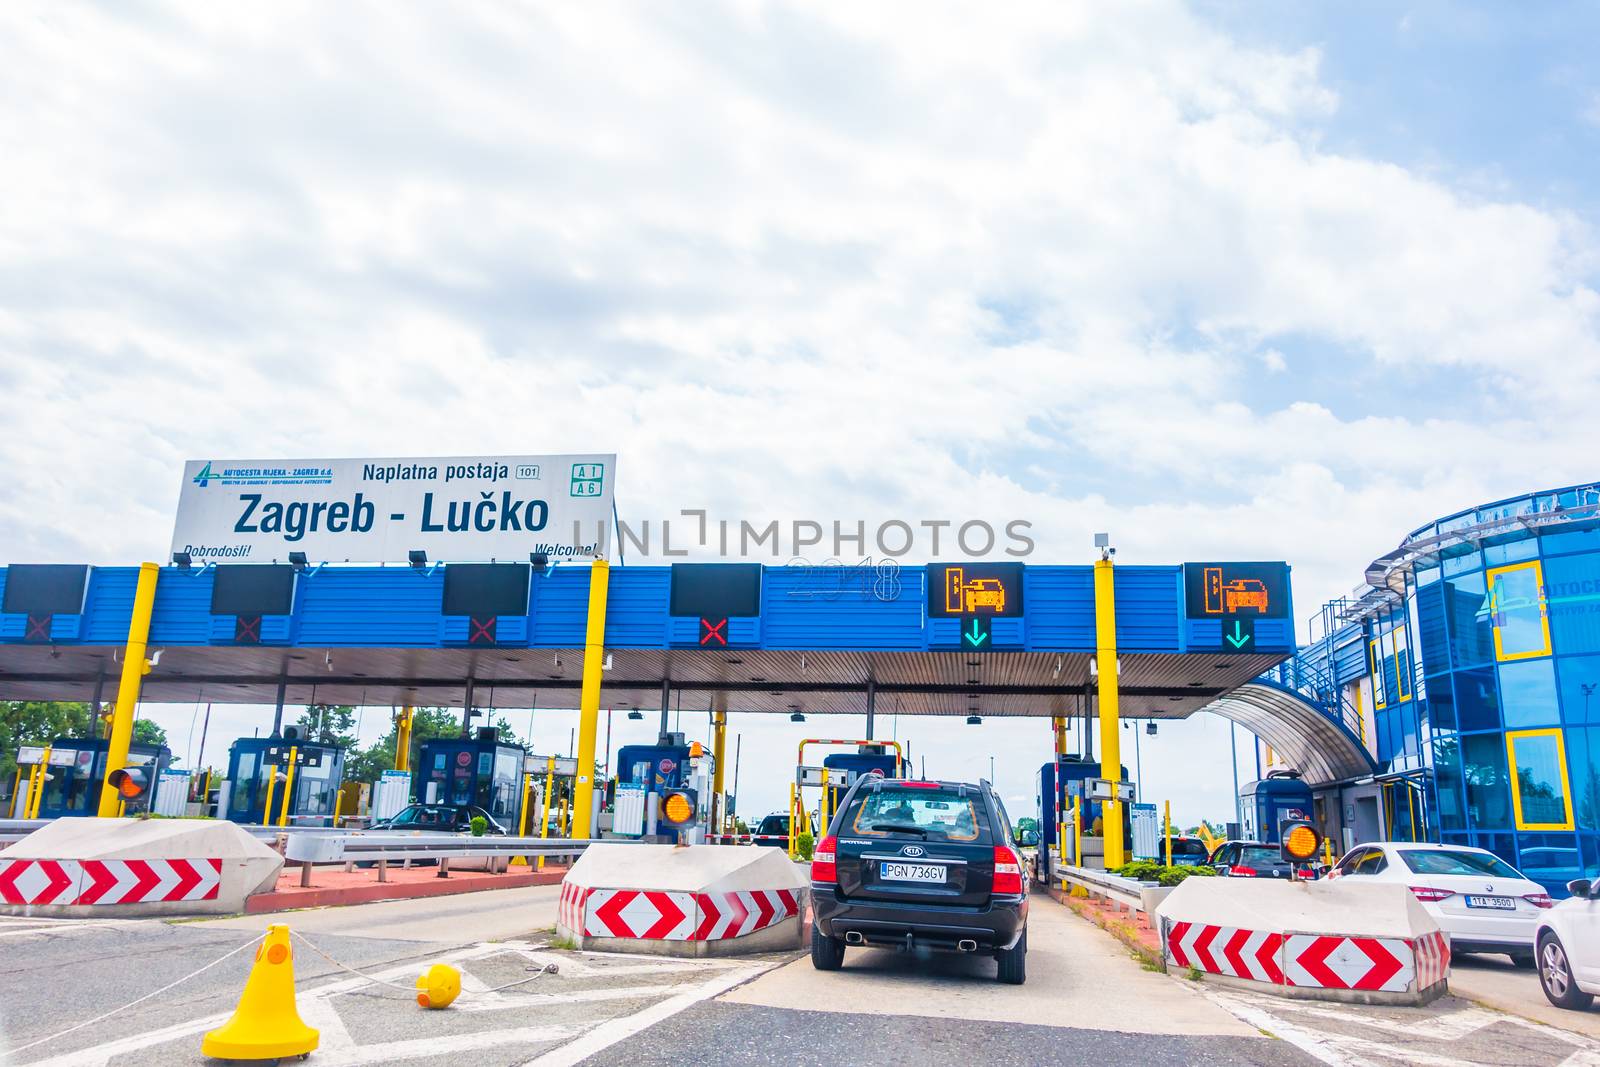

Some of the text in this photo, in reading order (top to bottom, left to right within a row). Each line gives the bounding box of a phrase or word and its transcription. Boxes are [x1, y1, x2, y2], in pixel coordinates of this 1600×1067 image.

[293, 468, 319, 476] ZAGREB
[363, 462, 509, 483] Naplatna postaja
[519, 467, 537, 477] 101
[234, 493, 375, 541] Zagreb
[421, 491, 549, 532] Lučko
[183, 544, 252, 557] Dobrodošli!
[535, 543, 598, 556] Welcome!
[906, 847, 920, 855] KIA
[887, 864, 944, 879] PGN 736GV
[1472, 896, 1487, 905] 1TA
